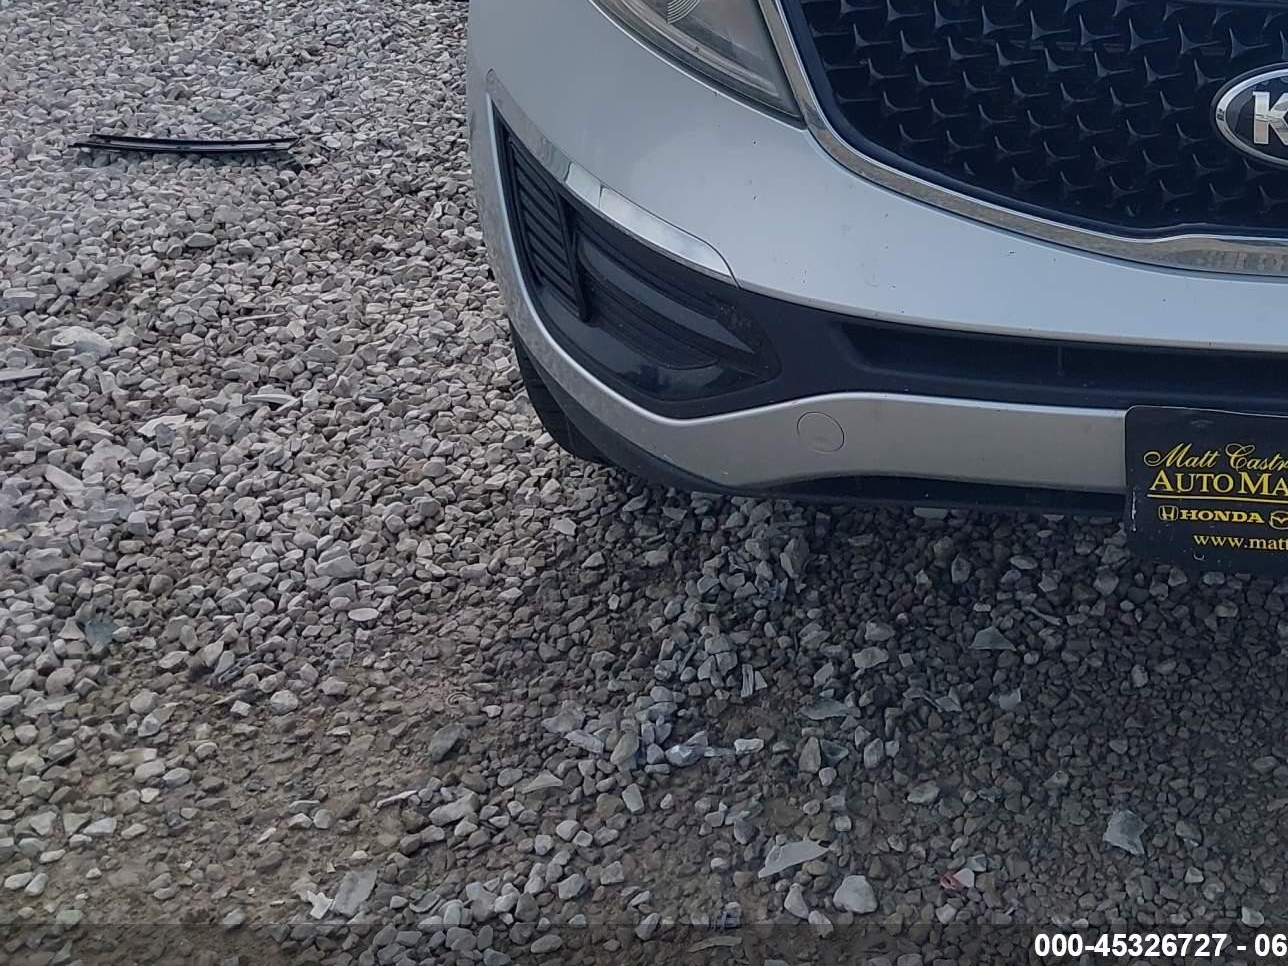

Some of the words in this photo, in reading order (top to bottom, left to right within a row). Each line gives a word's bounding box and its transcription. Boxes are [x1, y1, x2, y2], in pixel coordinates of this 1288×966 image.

[1143, 442, 1221, 468] Matt
[1149, 469, 1234, 493] AUTO
[1180, 509, 1265, 524] HONDA
